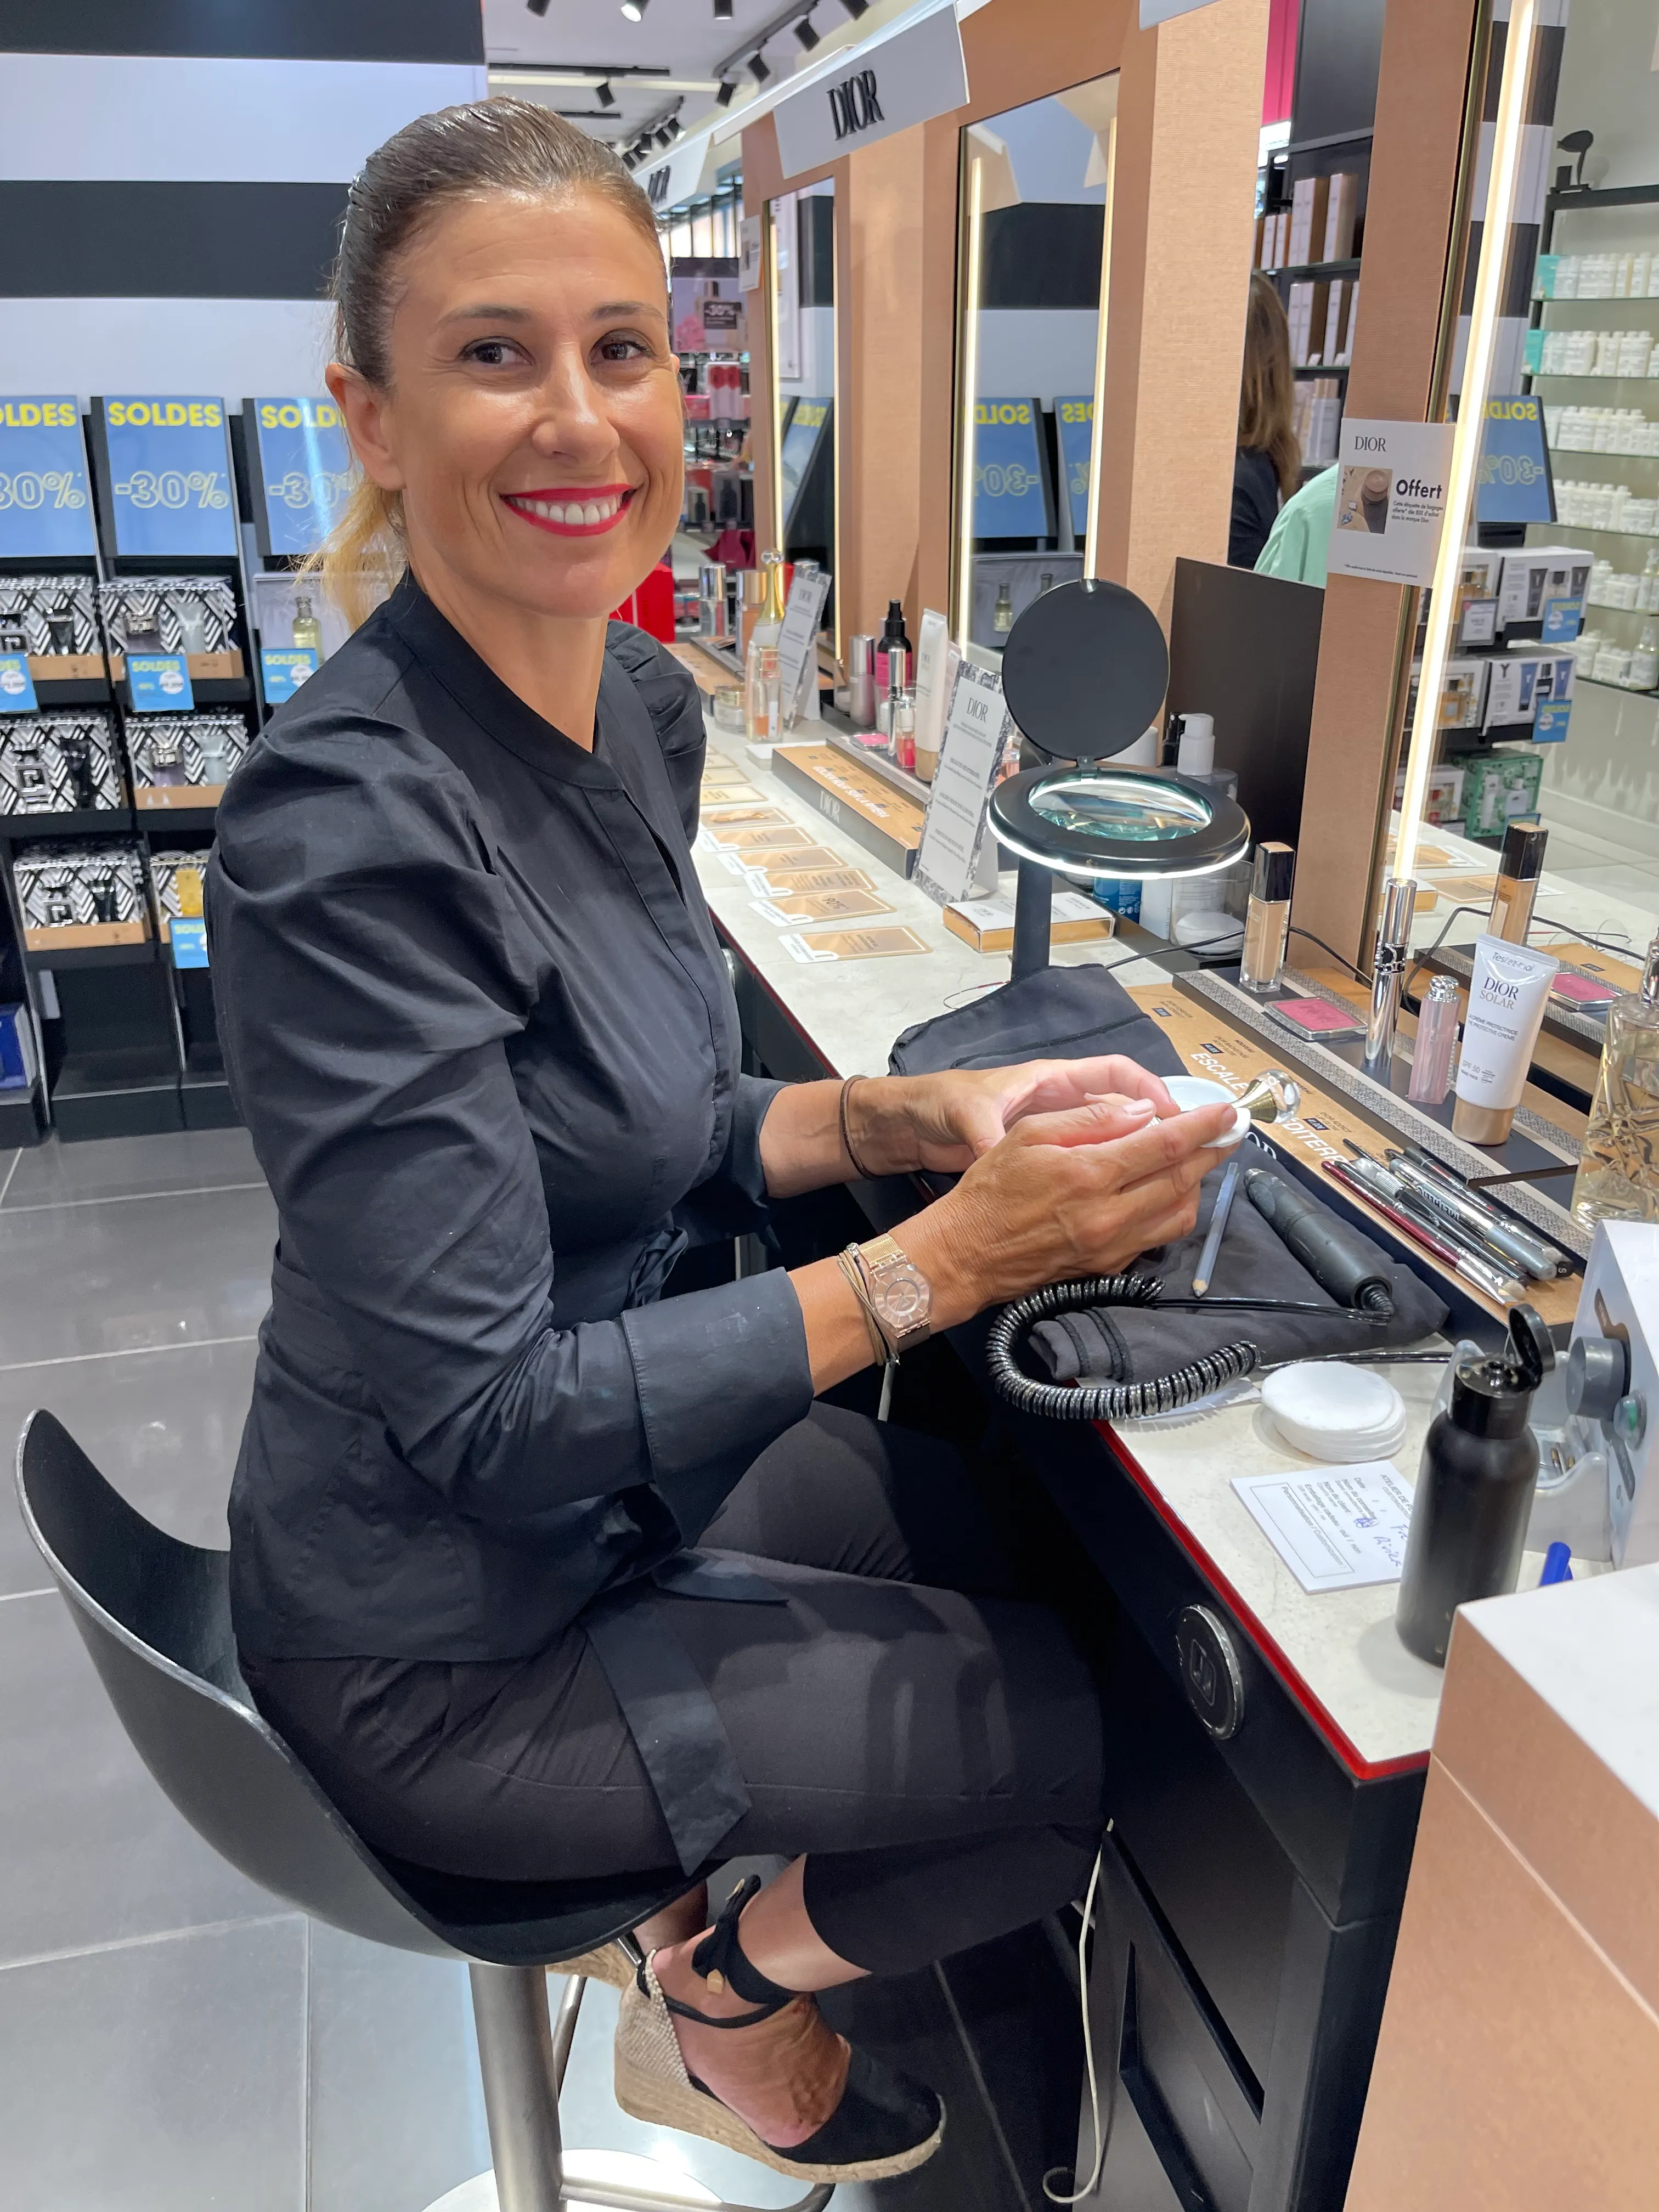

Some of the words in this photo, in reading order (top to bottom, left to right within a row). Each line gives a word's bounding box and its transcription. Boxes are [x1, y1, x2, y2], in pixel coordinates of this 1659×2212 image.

[826, 69, 885, 141] DIOR
[0, 403, 76, 427] LDES
[109, 402, 221, 427] SOLDES
[1355, 436, 1387, 452] DIOR
[1396, 479, 1442, 499] Offert
[967, 697, 988, 723] DIOR
[820, 791, 841, 823] DIOR
[1492, 951, 1535, 972] Testez-moi
[1479, 990, 1514, 1010] SOLAR
[1483, 977, 1519, 1001] DIOR
[1190, 1053, 1249, 1091] ESCALE
[1472, 1065, 1481, 1074] 50
[1282, 1118, 1349, 1164] DITERR
[1380, 1474, 1401, 1496] ATELIER
